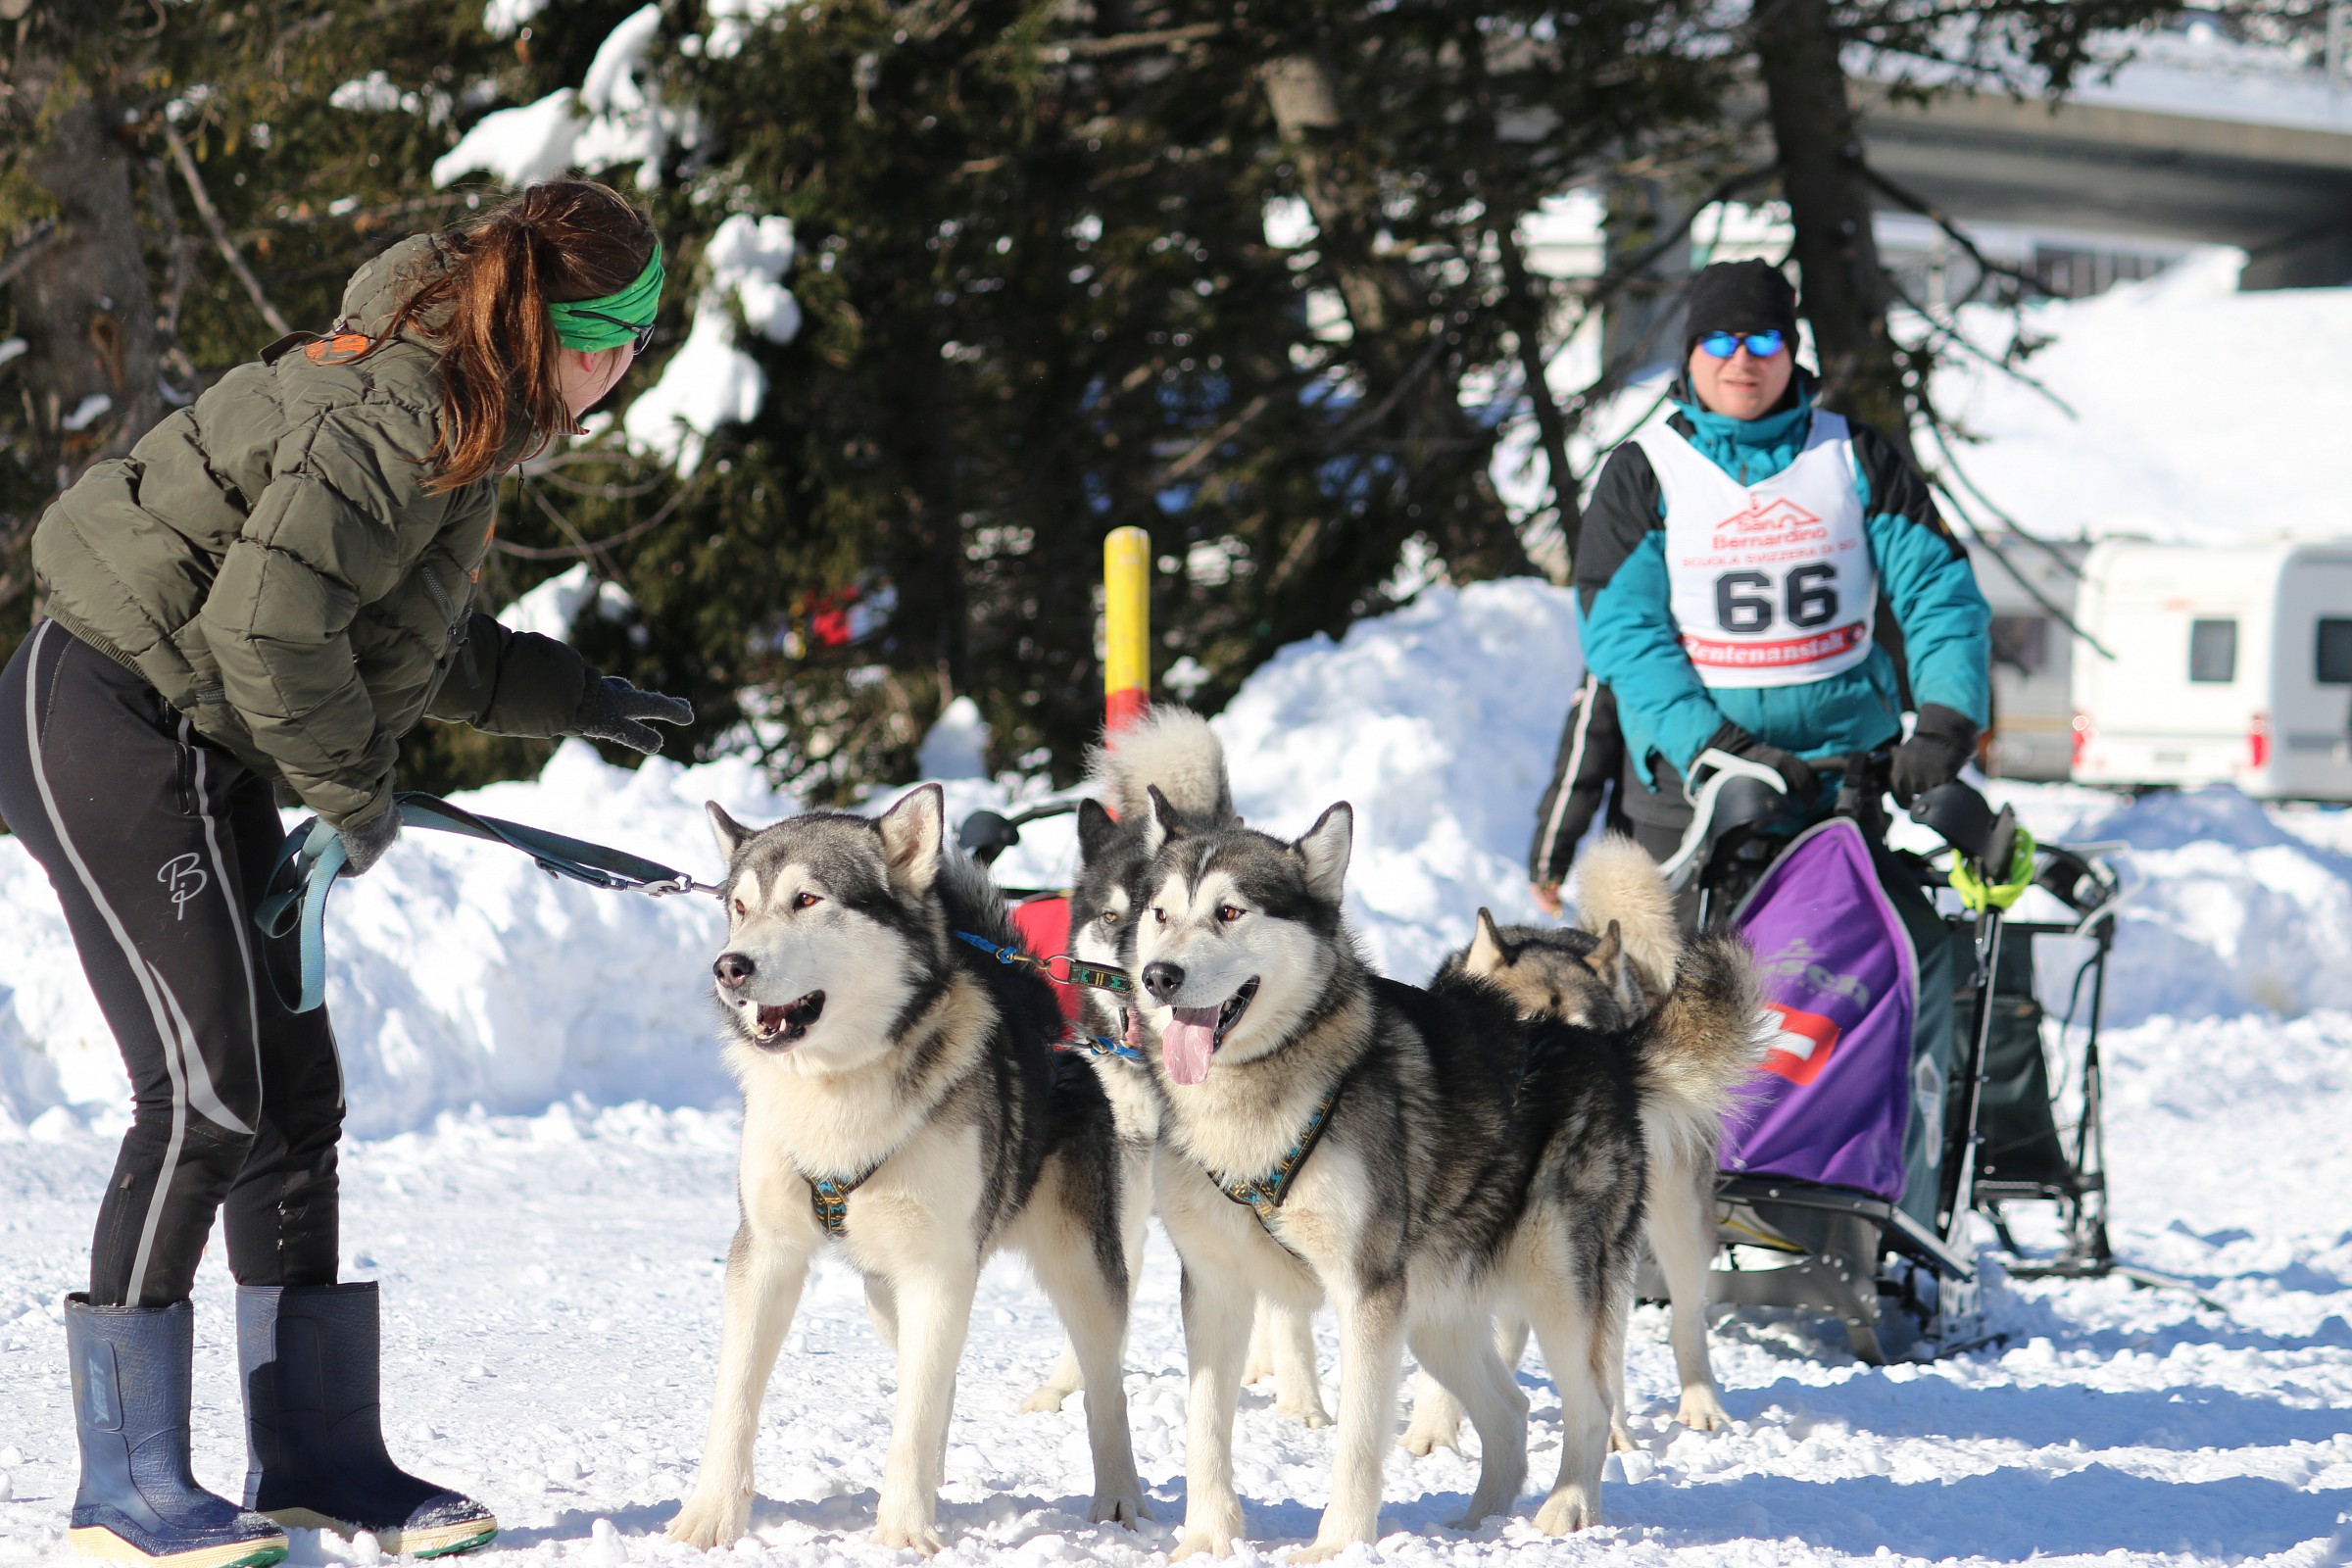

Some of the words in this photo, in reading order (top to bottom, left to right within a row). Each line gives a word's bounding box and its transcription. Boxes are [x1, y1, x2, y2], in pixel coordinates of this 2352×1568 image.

[1737, 516, 1775, 533] San
[1713, 527, 1828, 549] Bernardino
[1715, 565, 1838, 633] 66
